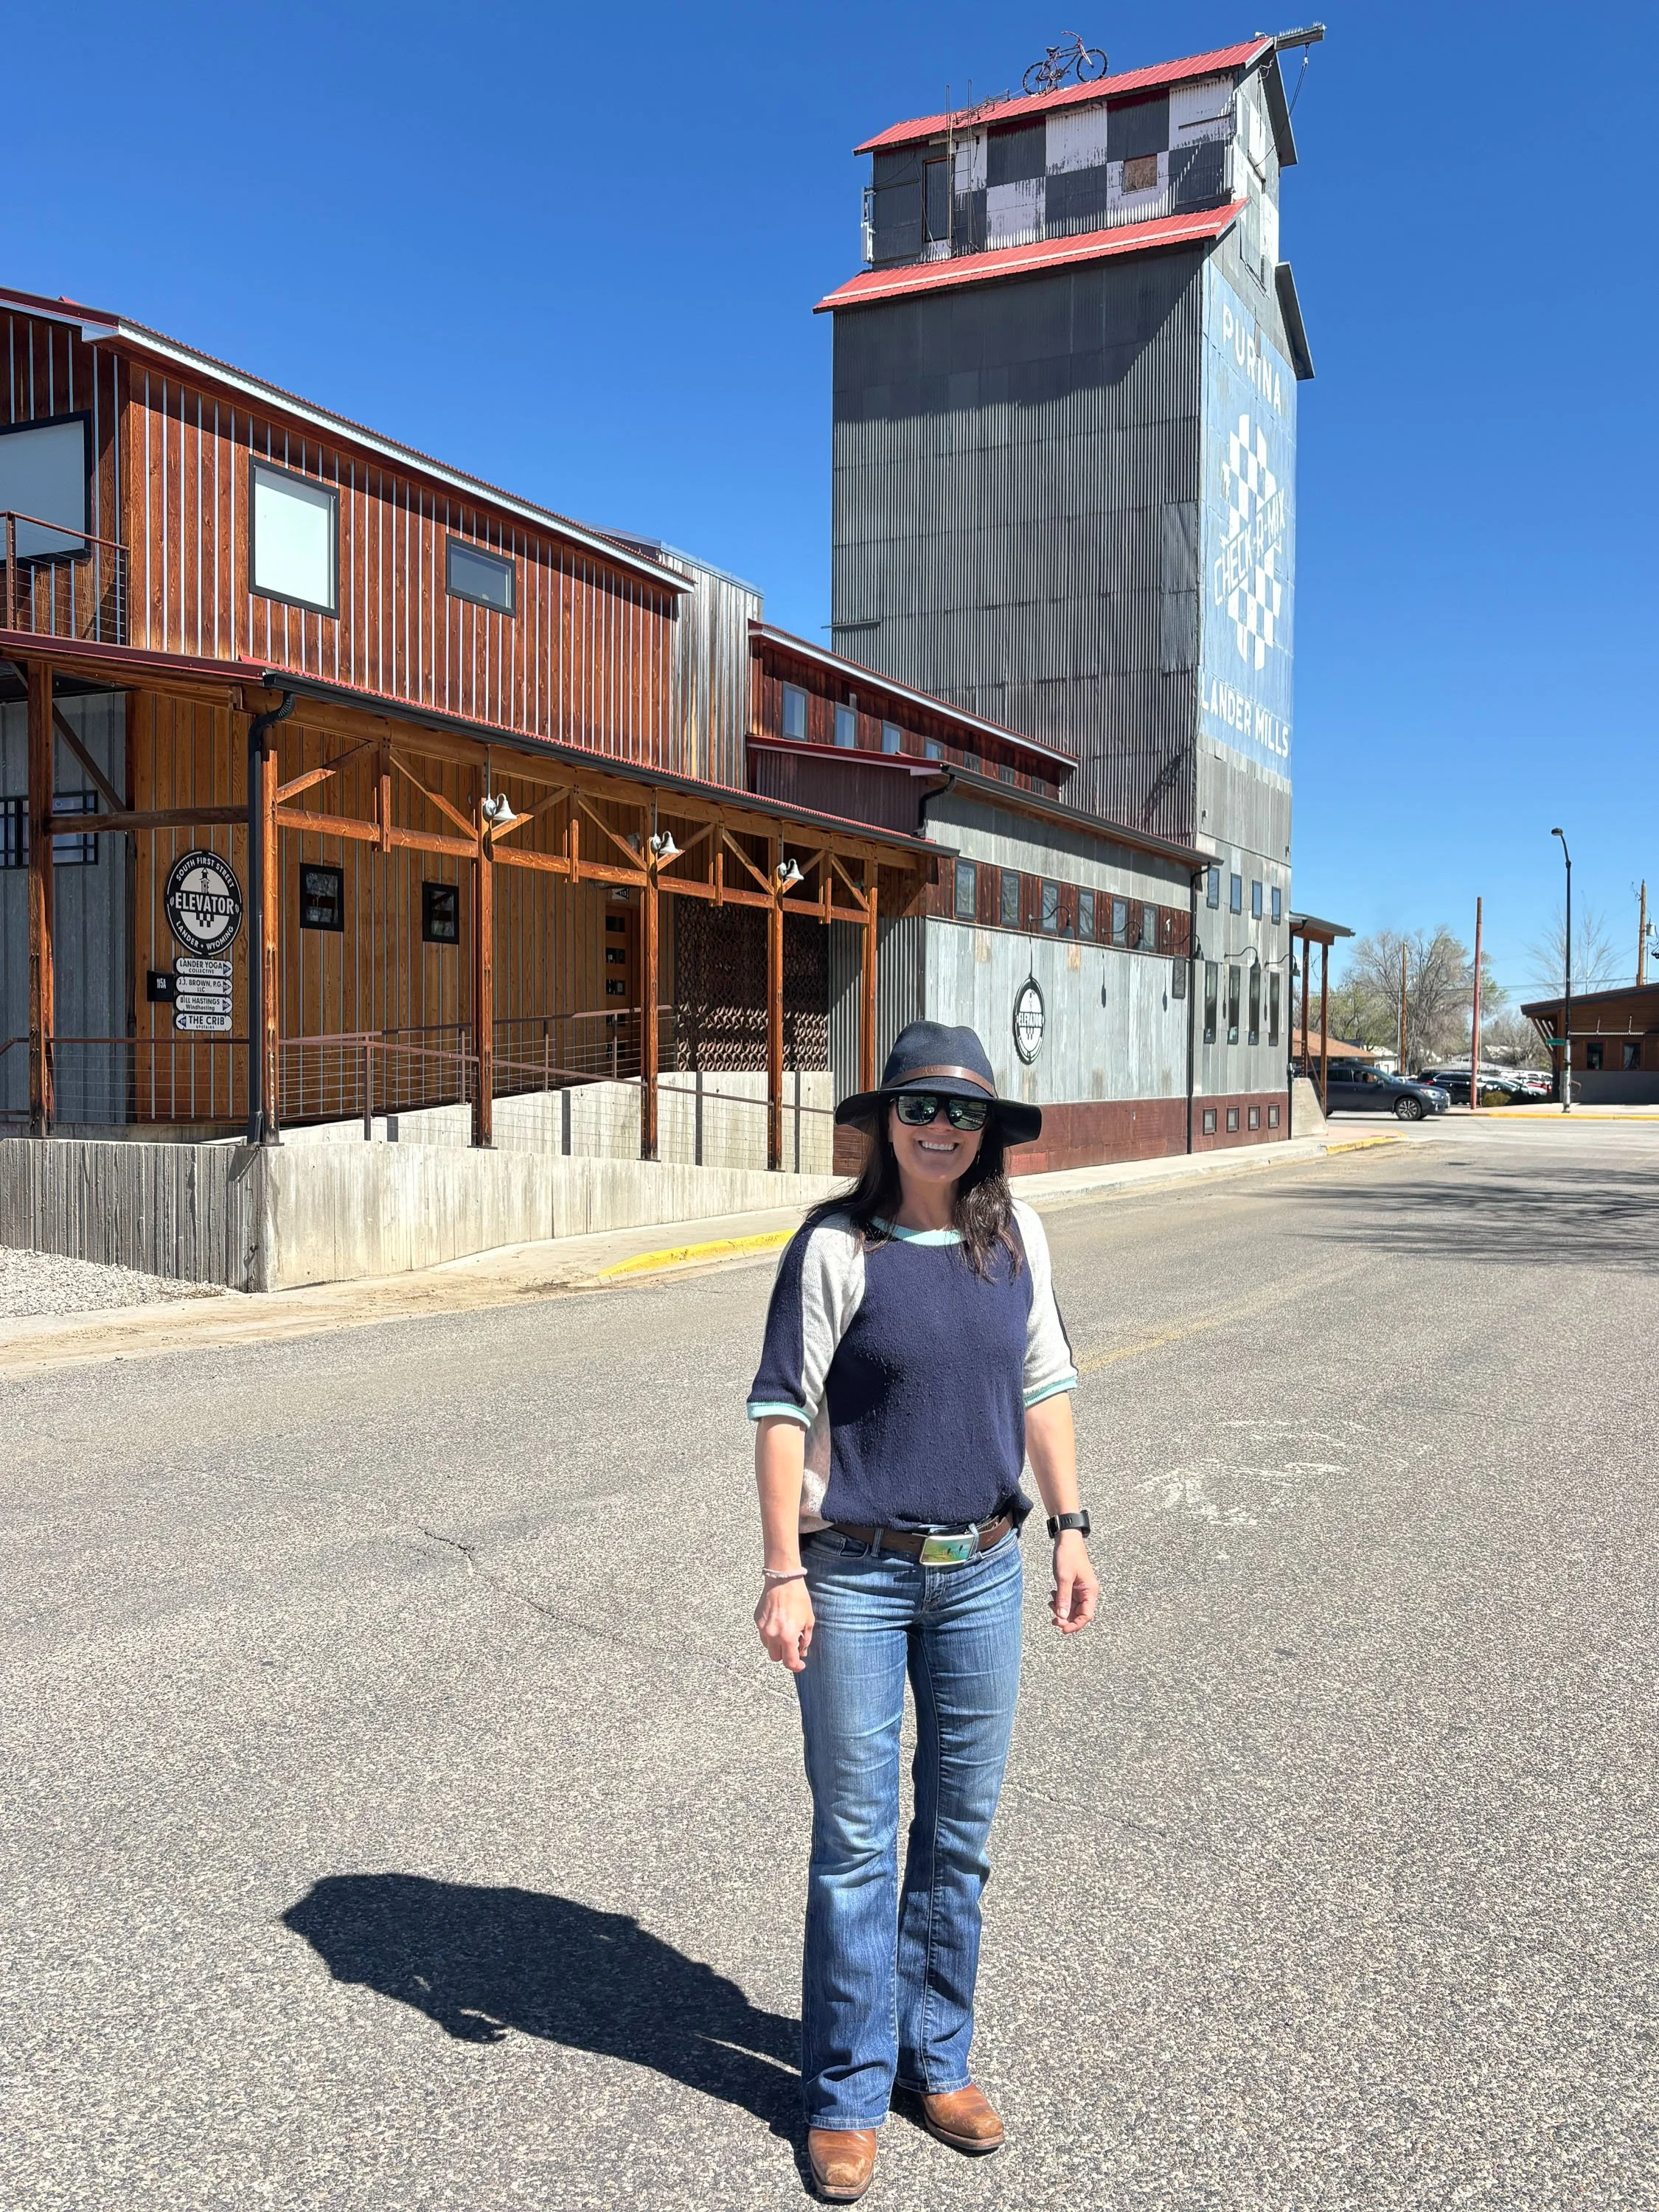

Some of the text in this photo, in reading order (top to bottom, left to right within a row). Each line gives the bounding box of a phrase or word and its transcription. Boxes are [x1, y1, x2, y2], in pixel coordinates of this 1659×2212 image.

[1222, 302, 1281, 416] PURINA
[1201, 672, 1288, 758] LANDER MILLS
[176, 857, 234, 888] SOUTH FIRST STREET
[175, 892, 234, 914] ELEVATOR
[176, 921, 234, 950] LANDER WYOMING
[180, 960, 204, 968] LANDER
[189, 979, 212, 987] BROWN,
[189, 1015, 204, 1024] THE
[206, 1016, 225, 1025] CRIB
[1018, 1012, 1042, 1027] ELEVATOR
